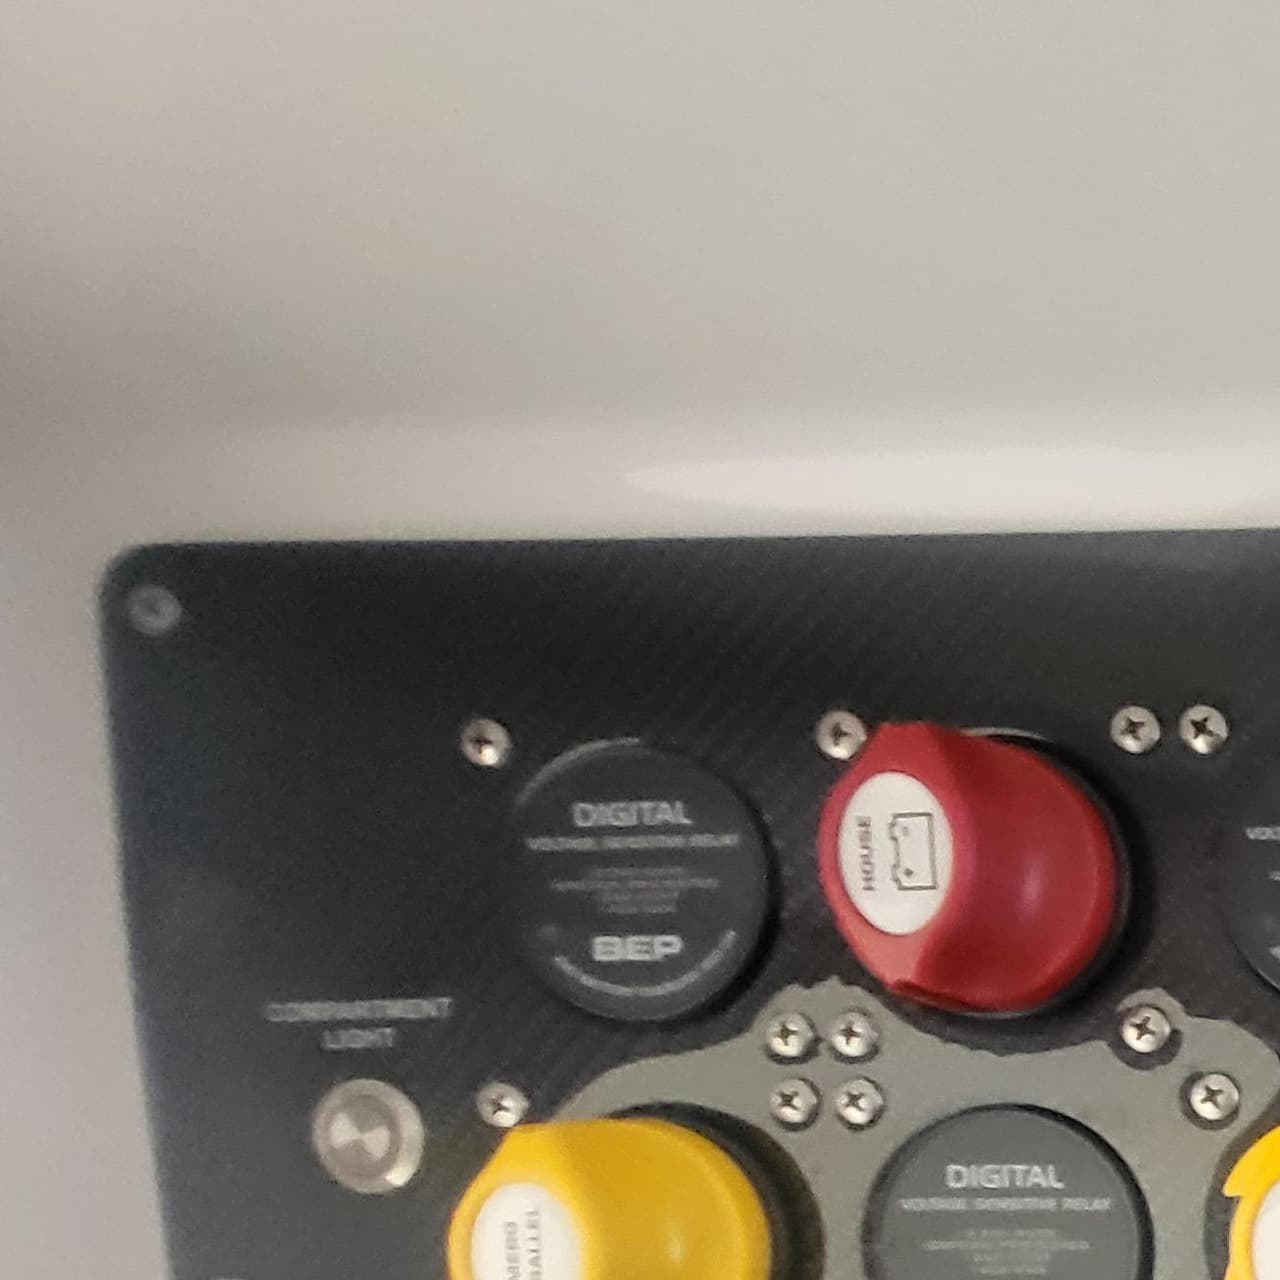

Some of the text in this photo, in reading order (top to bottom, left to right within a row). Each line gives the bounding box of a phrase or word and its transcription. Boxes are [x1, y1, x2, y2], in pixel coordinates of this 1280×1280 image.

[573, 800, 692, 828] DIGITAL
[857, 816, 875, 891] HOUSE
[592, 934, 682, 962] BEP
[946, 1164, 1064, 1190] DIGITAL
